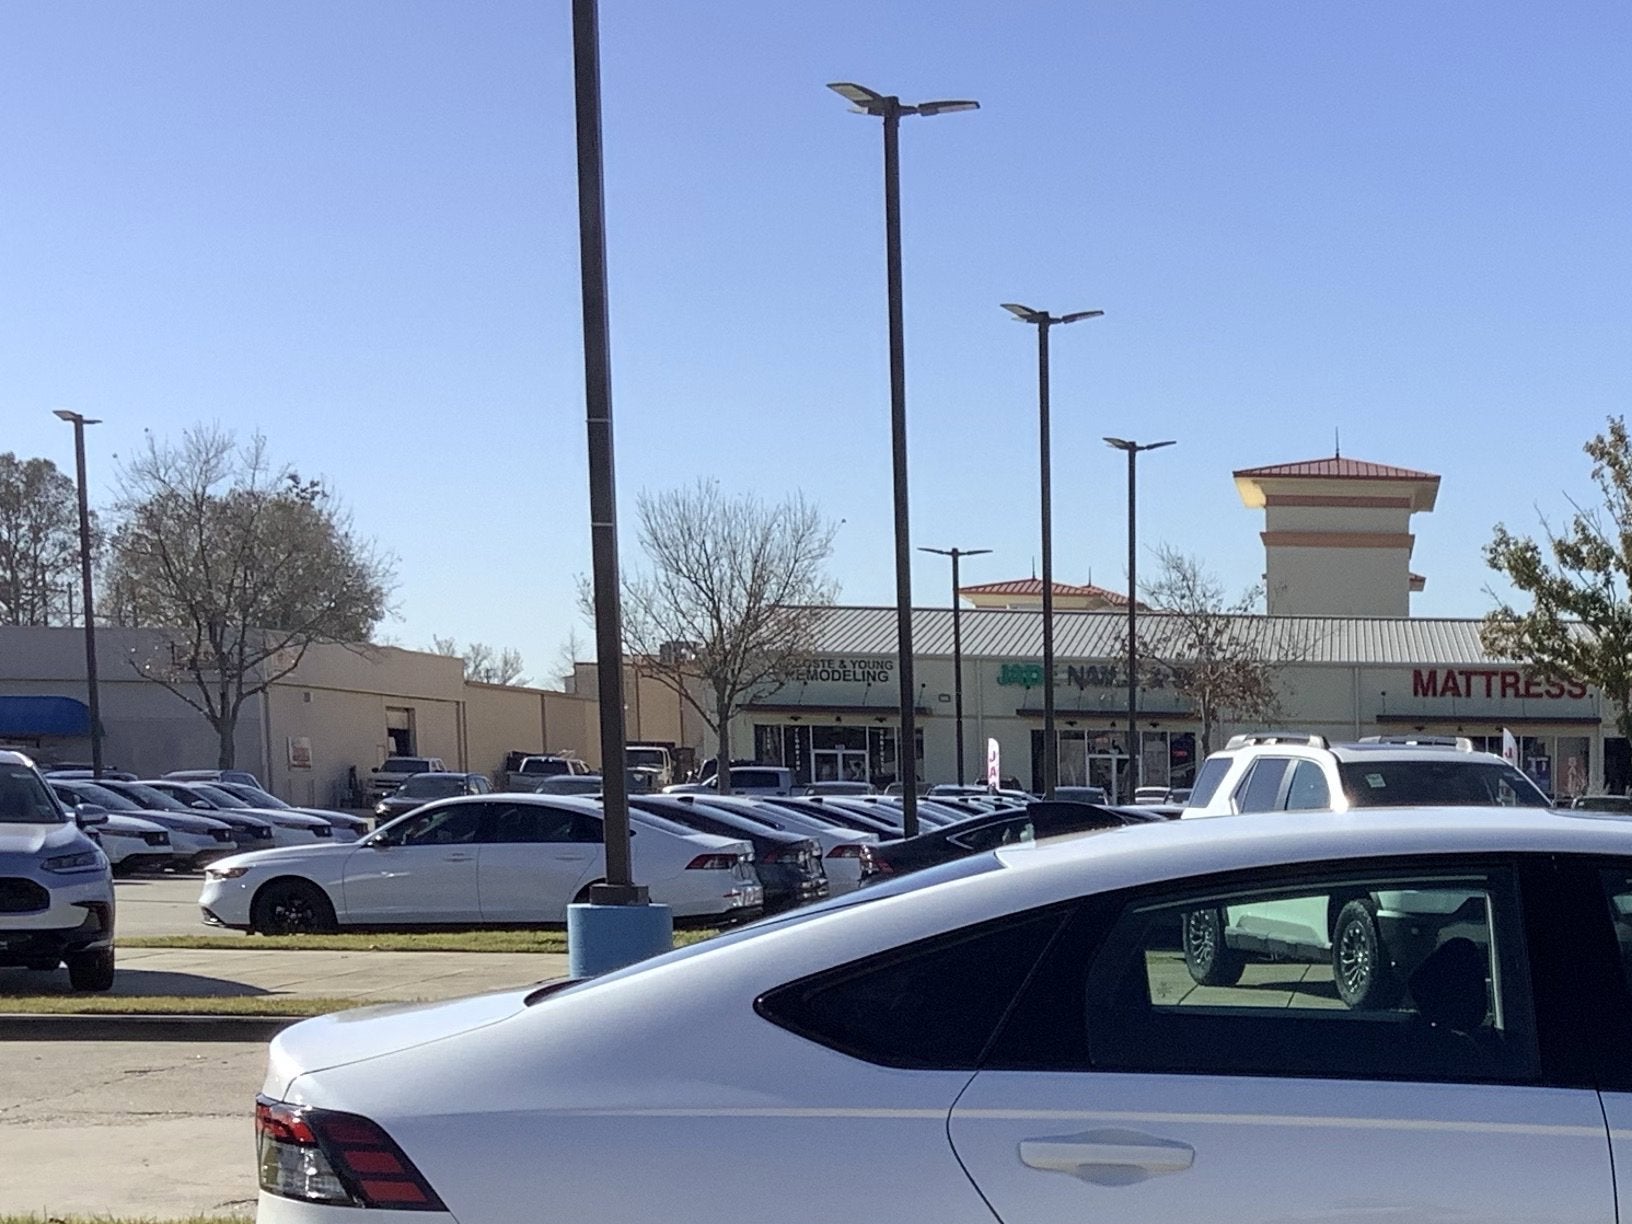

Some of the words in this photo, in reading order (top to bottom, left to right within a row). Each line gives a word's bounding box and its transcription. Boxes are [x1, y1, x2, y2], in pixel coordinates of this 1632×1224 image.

[840, 659, 848, 669] &
[850, 660, 894, 670] YOUNG
[1412, 669, 1588, 699] MATTRESS
